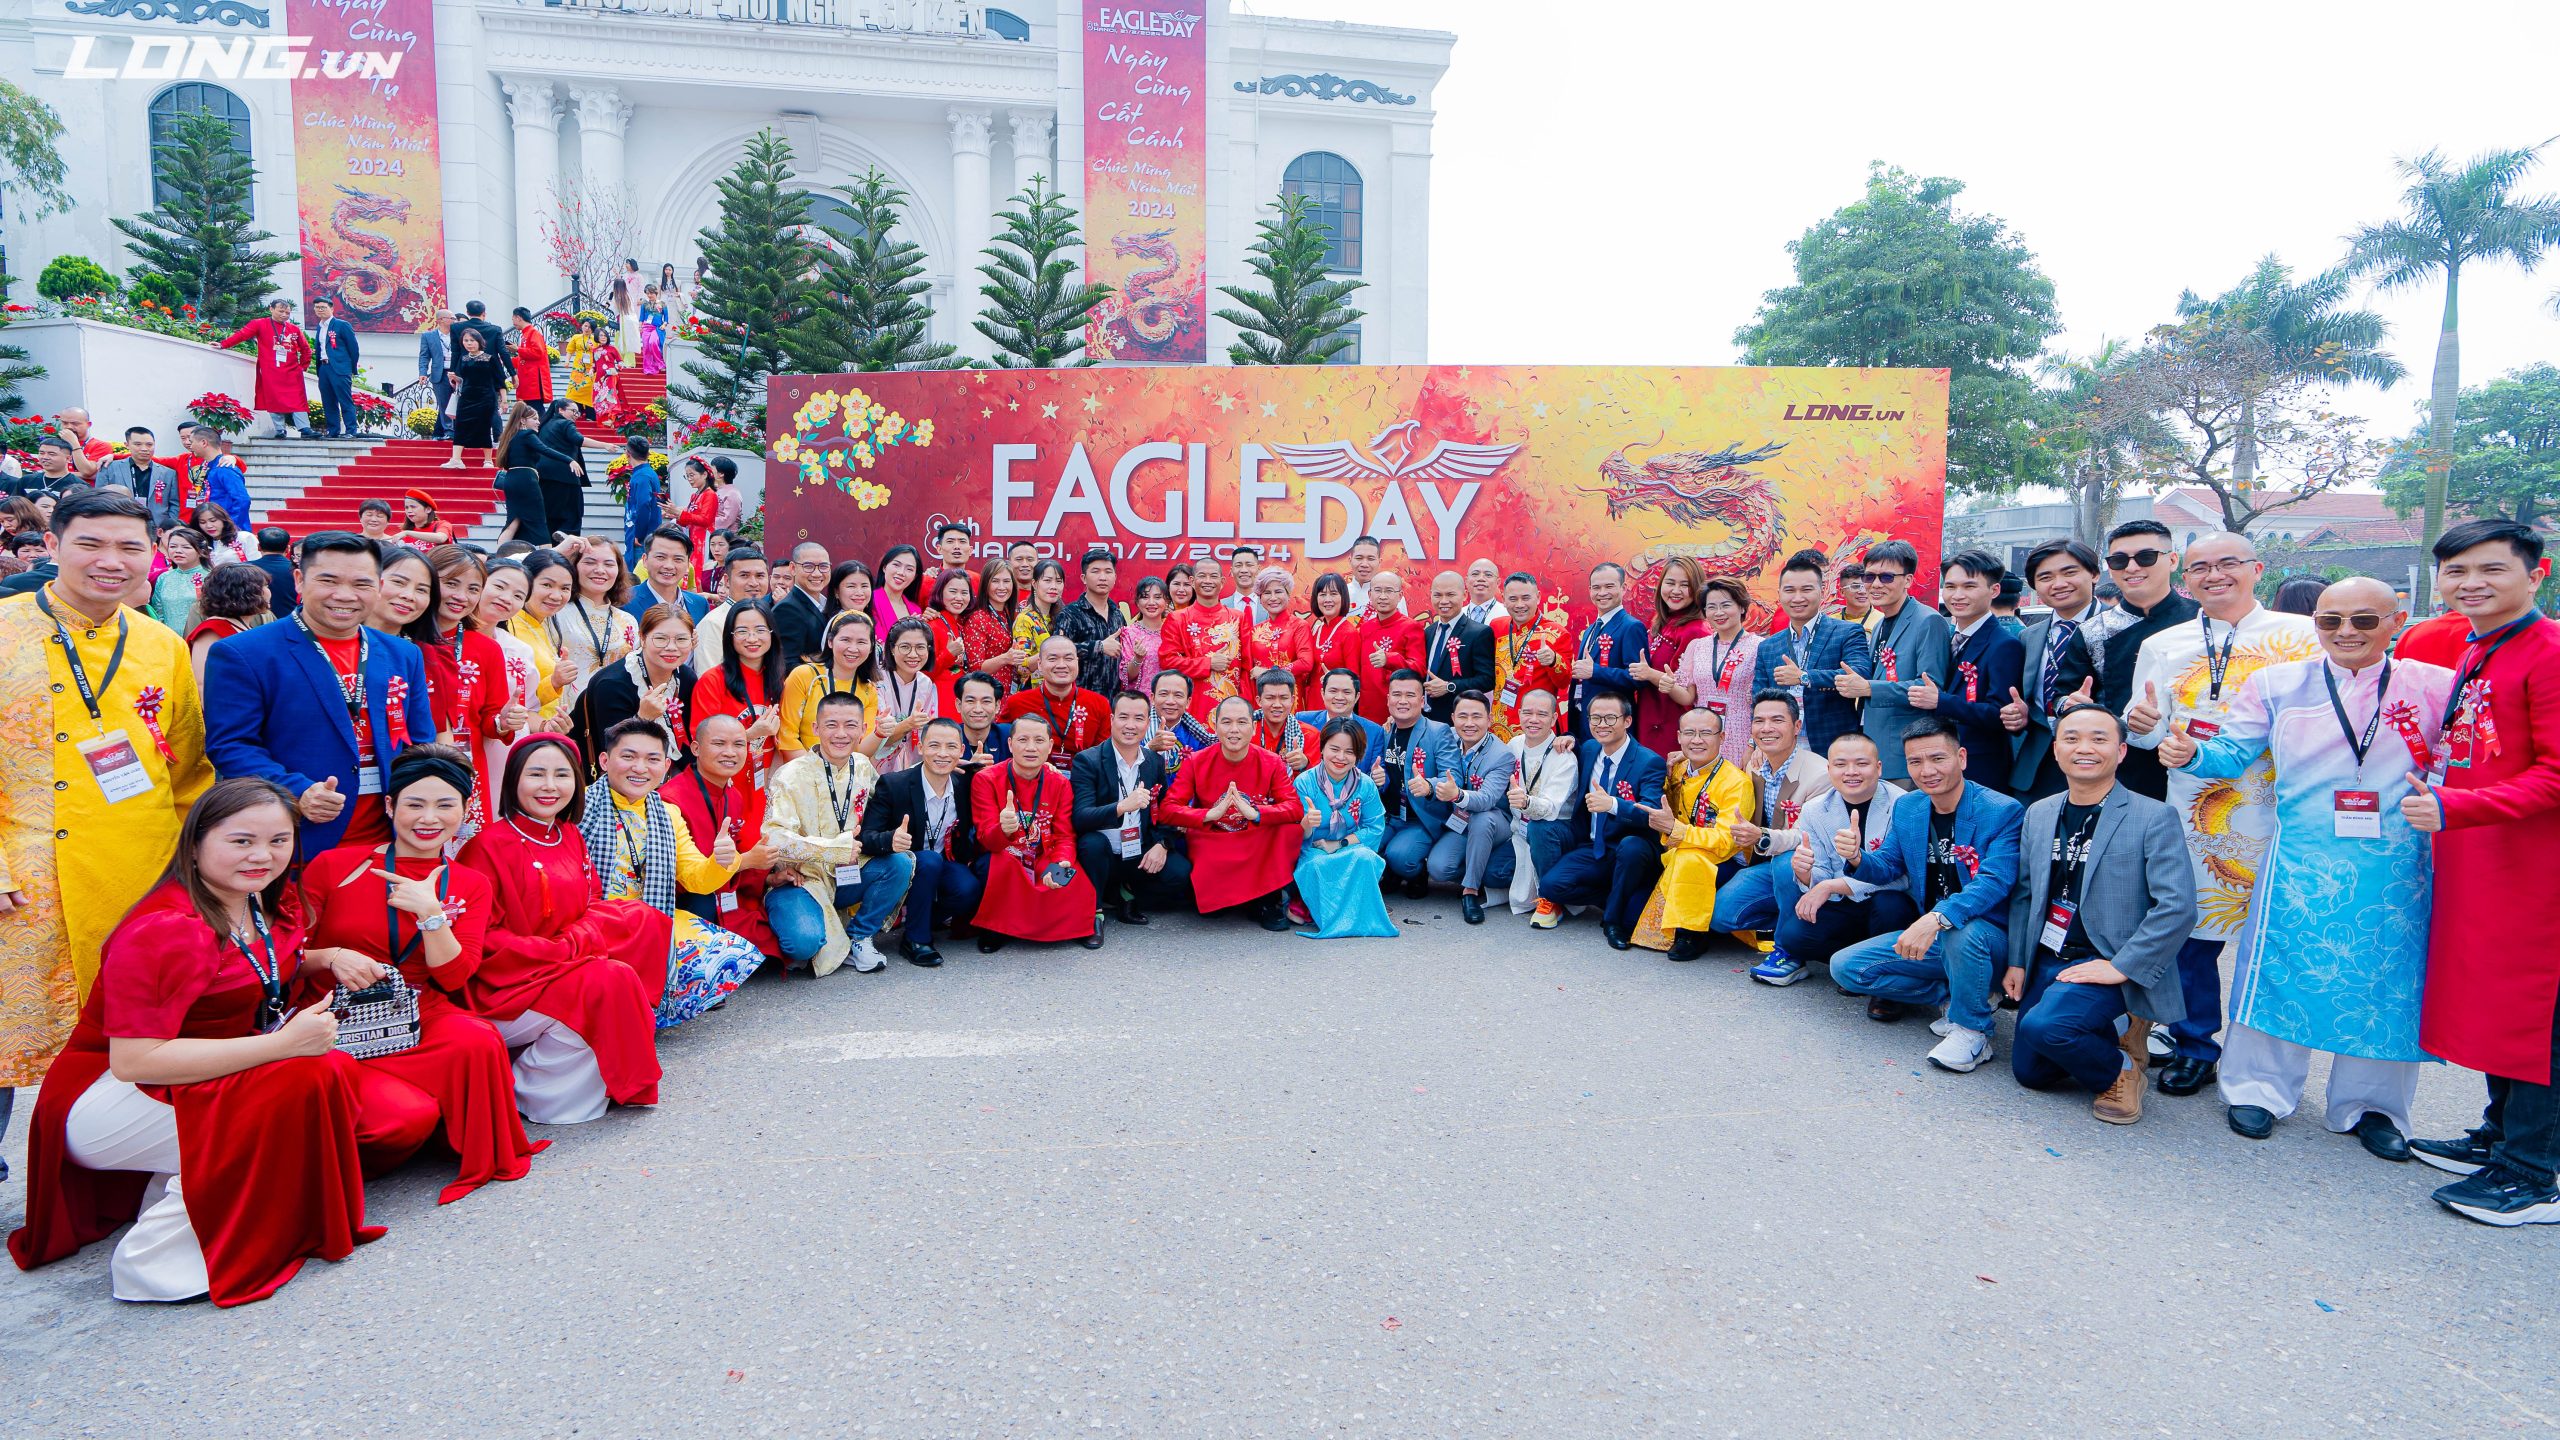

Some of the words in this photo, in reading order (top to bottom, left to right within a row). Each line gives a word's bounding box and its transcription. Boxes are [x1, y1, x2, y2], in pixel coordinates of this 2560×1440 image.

[1100, 8, 1163, 32] EAGLE
[1162, 20, 1196, 38] DAY
[348, 18, 417, 53] Cùng
[1104, 43, 1169, 76] Ngày
[1134, 75, 1192, 106] Cùng
[303, 112, 346, 128] Chúc
[349, 115, 397, 136] Mừng
[346, 134, 385, 149] Năm
[1127, 126, 1184, 149] Cánh
[348, 157, 405, 177] 2024
[1092, 159, 1128, 173] Chúc
[1132, 162, 1171, 181] Mừng
[1127, 179, 1161, 193] Năm
[1128, 200, 1176, 219] 2024
[991, 441, 1305, 539] EAGLE
[1304, 480, 1481, 560] DAY
[80, 680, 92, 698] EAGLE
[2363, 730, 2374, 746] EAGLE
[257, 966, 270, 984] EAGLE
[388, 1024, 411, 1037] DIOR
